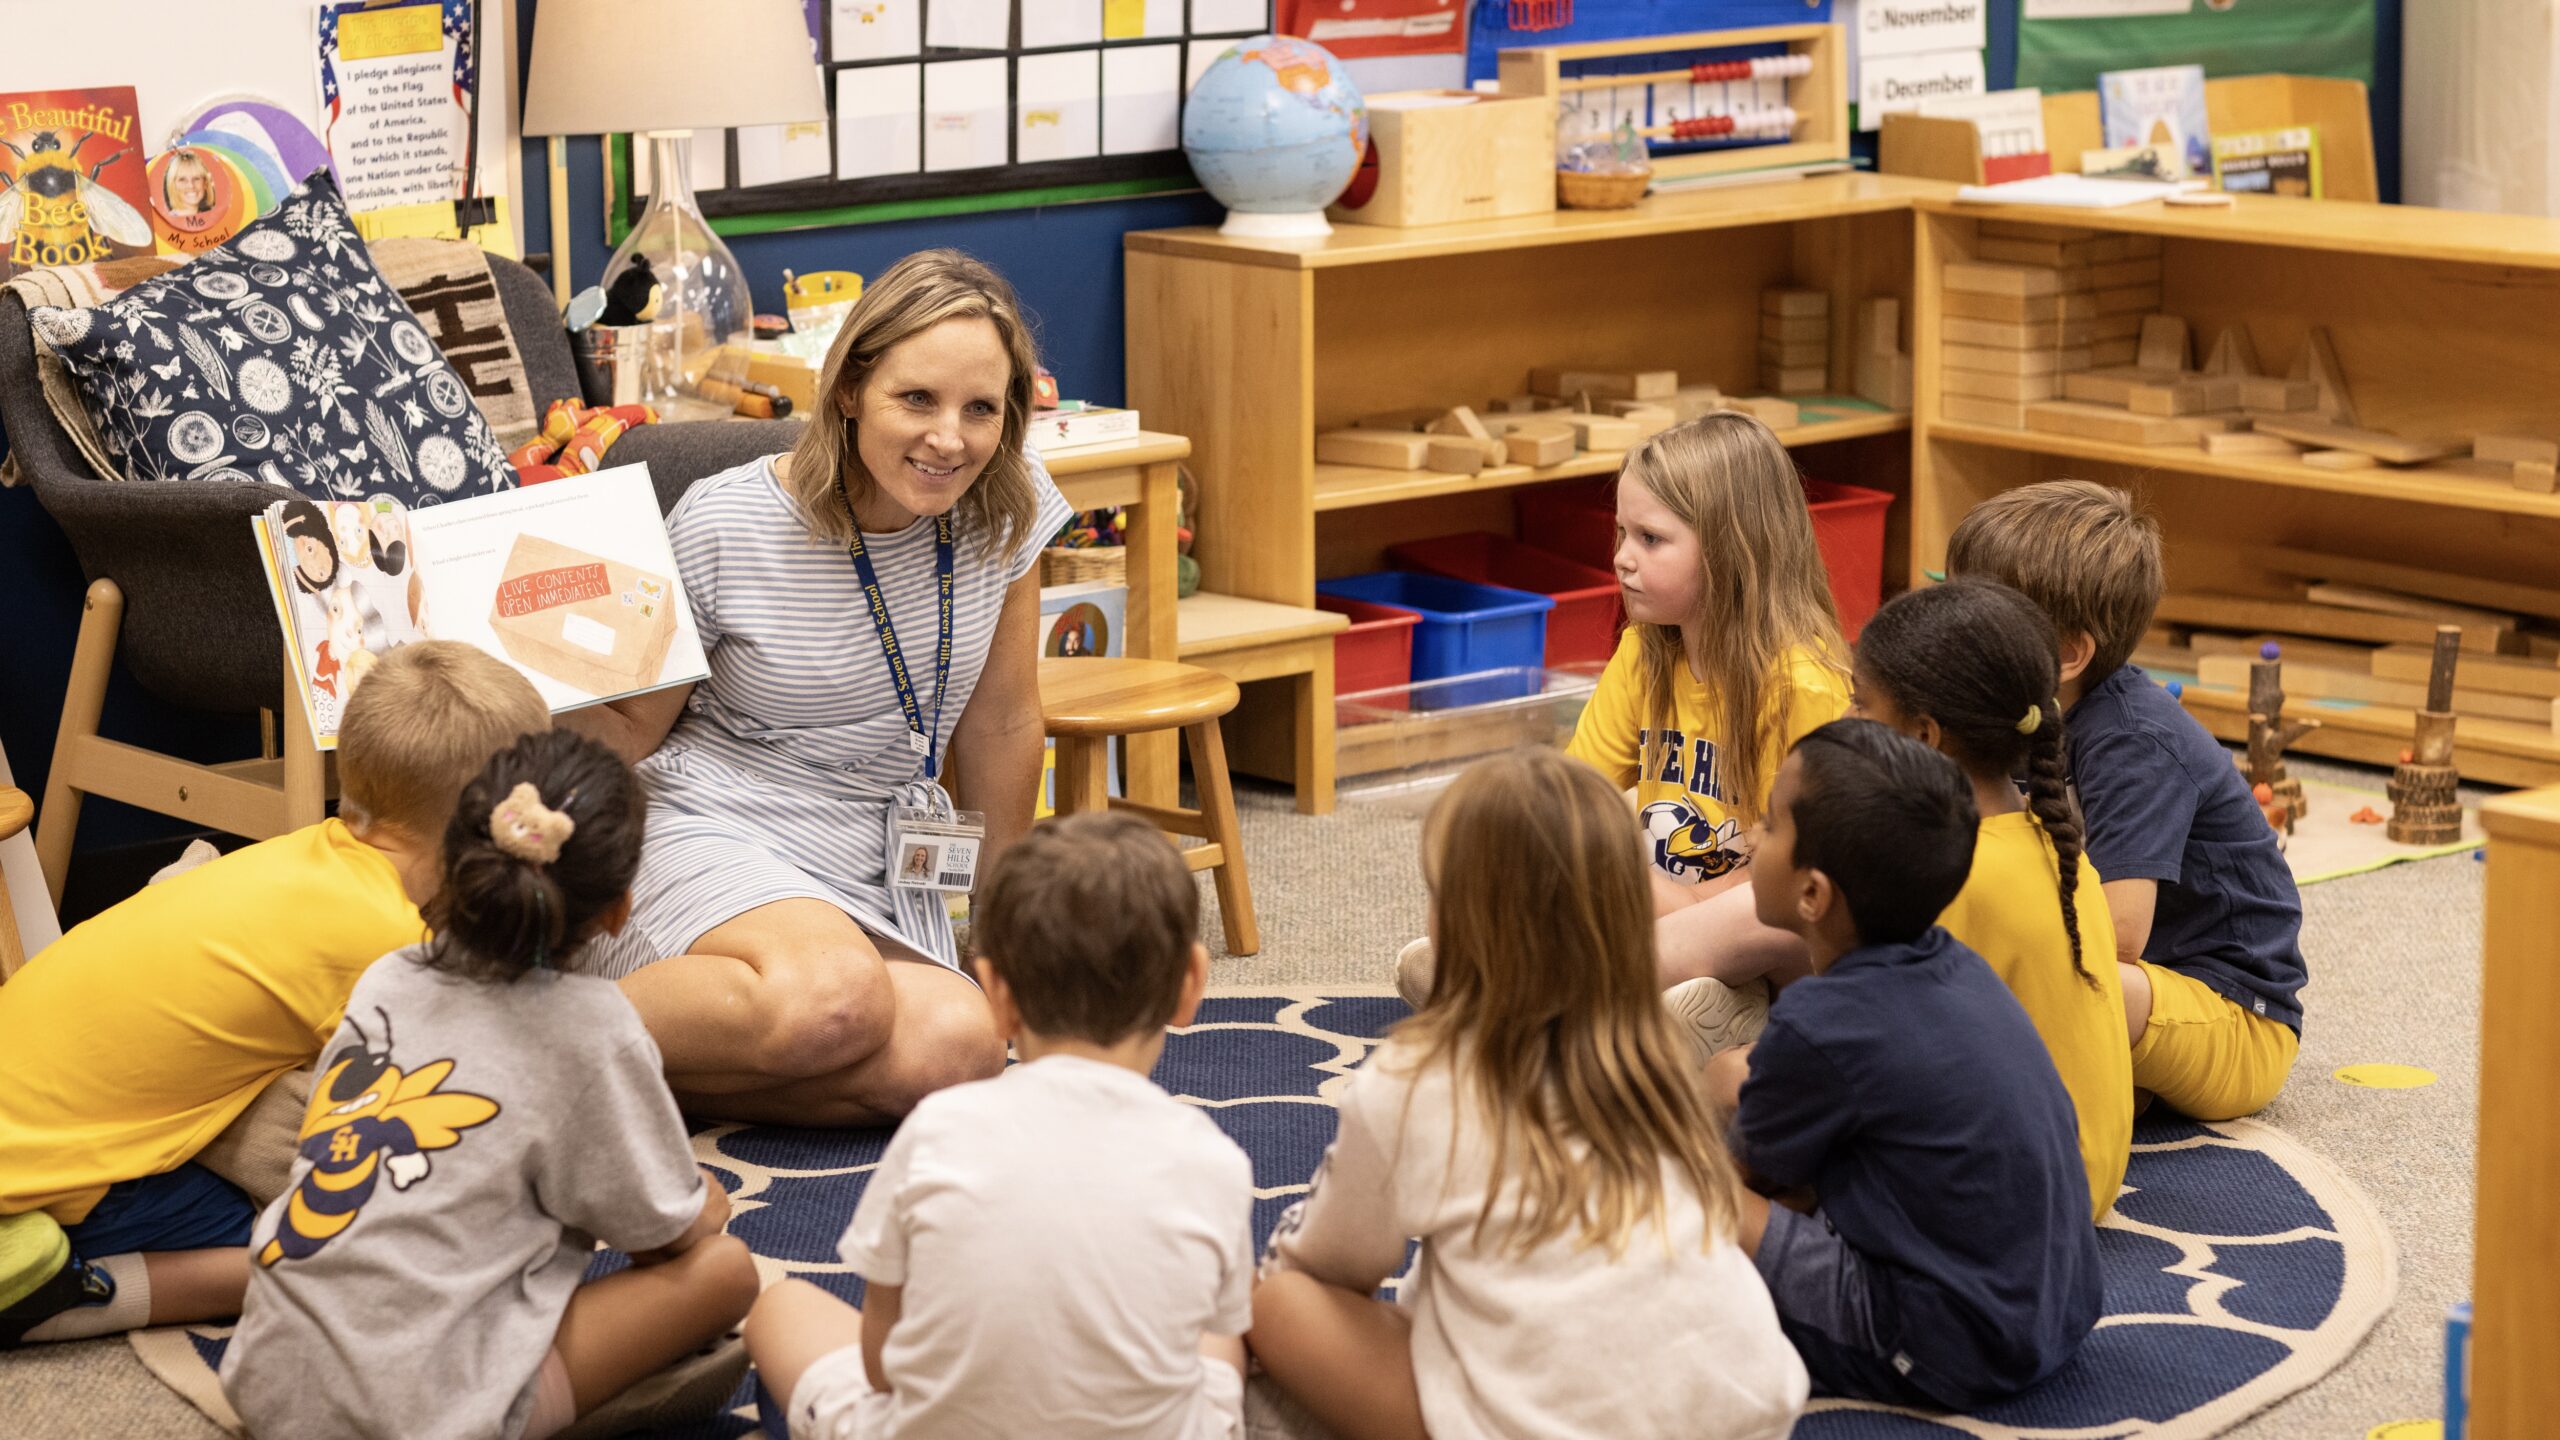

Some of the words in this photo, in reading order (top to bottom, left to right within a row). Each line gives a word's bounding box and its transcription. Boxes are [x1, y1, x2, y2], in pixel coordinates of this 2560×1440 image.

[1885, 2, 1975, 27] November
[354, 67, 388, 82] pledge
[392, 63, 442, 77] allegiance
[368, 87, 379, 95] to
[382, 84, 399, 94] the
[402, 82, 424, 93] Flag
[1886, 73, 1972, 100] December
[346, 105, 358, 115] of
[360, 102, 376, 113] the
[380, 98, 414, 111] United
[417, 96, 448, 107] States
[8, 102, 133, 143] Beautiful
[369, 118, 380, 129] of
[351, 138, 369, 149] and
[373, 137, 383, 146] to
[387, 133, 403, 145] the
[407, 128, 448, 142] Republic
[352, 156, 366, 166] for
[370, 151, 399, 164] which
[403, 150, 410, 159] it
[345, 174, 363, 184] one
[367, 168, 400, 181] Nation
[404, 164, 432, 177] under
[402, 182, 424, 194] with
[20, 192, 89, 226] Bee
[186, 215, 206, 228] Me
[9, 228, 113, 267] Book
[168, 232, 185, 250] My
[193, 227, 230, 249] School
[501, 579, 532, 599] LIVE
[536, 564, 600, 590] CONTENTS
[941, 572, 953, 595] The
[502, 597, 533, 617] OPEN
[536, 580, 607, 608] IMMEDIATELY
[864, 584, 888, 625] School
[942, 598, 953, 634] Seven
[881, 626, 897, 655] Hills
[939, 638, 950, 666] Hills
[892, 656, 909, 692] Seven
[935, 670, 948, 709] School
[904, 693, 917, 715] The
[947, 854, 970, 863] HILLS
[948, 847, 972, 855] SEVEN
